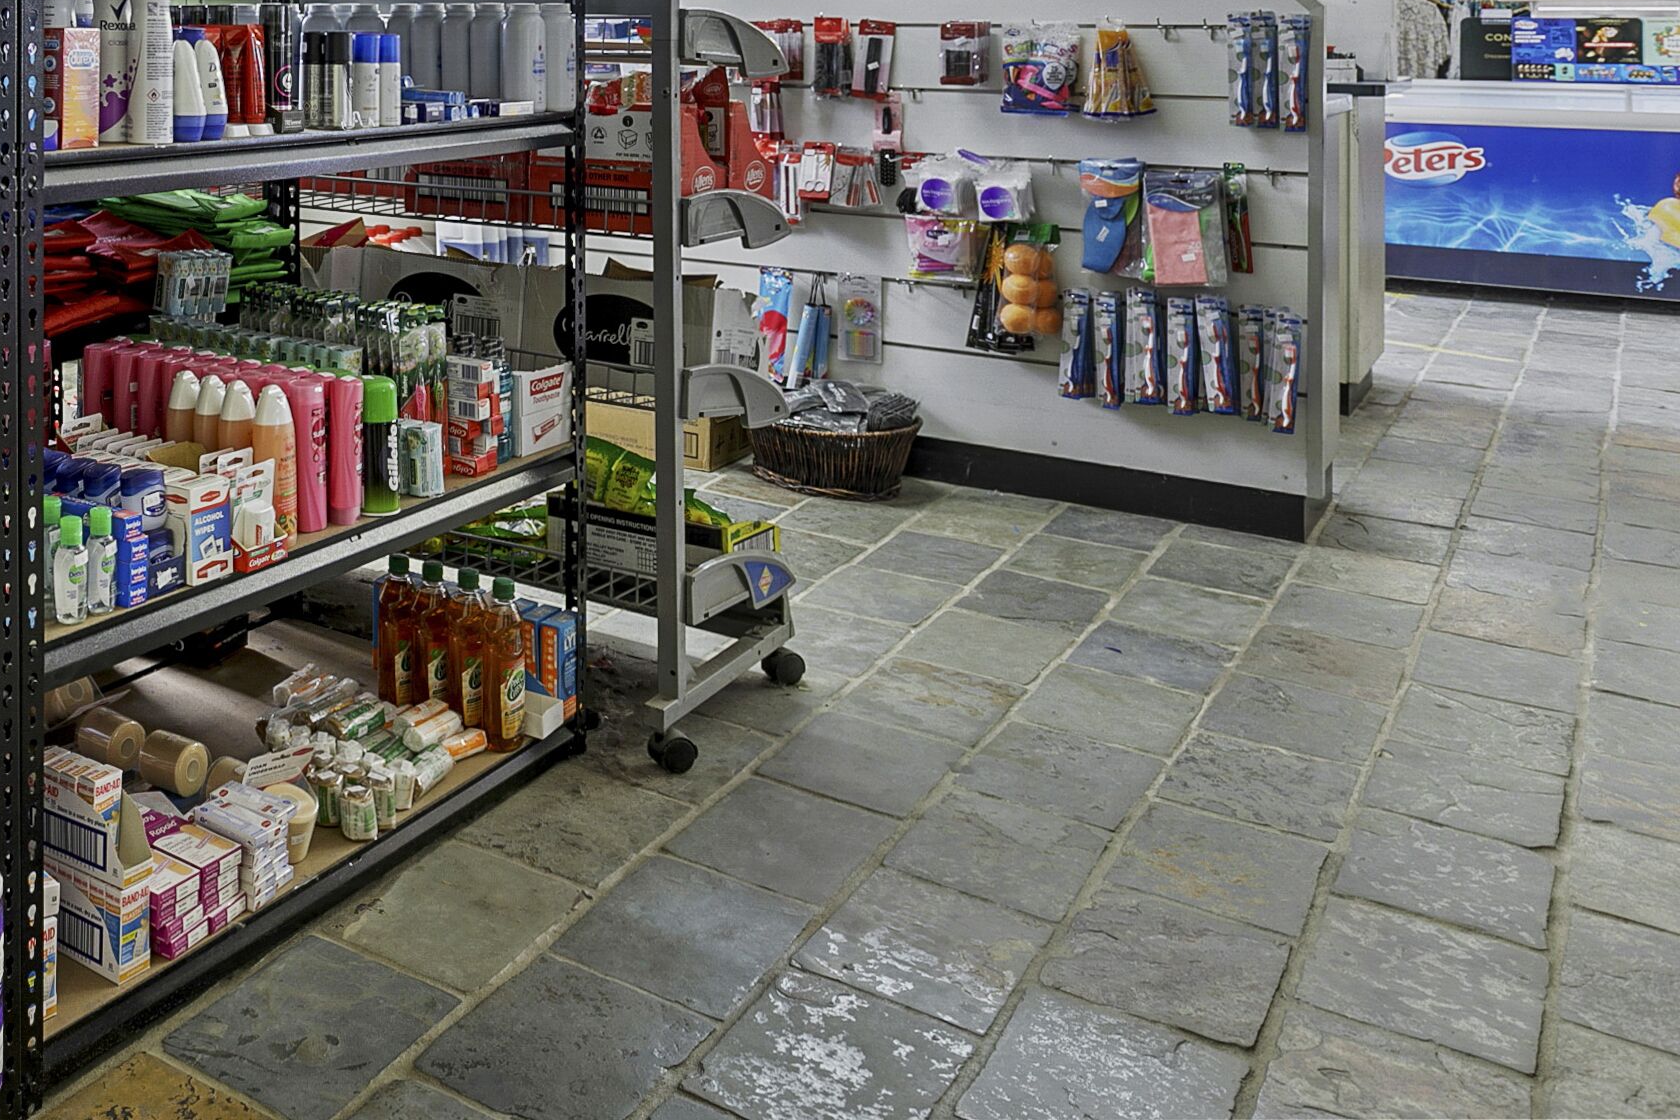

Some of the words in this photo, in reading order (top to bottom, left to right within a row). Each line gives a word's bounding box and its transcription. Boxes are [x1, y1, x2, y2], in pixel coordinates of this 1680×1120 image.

[531, 373, 564, 395] Colgate
[533, 391, 561, 405] Toothpaste
[387, 424, 399, 491] Gillette
[194, 511, 224, 526] ALCOHOL
[194, 523, 215, 536] WIPES
[248, 554, 271, 568] Colgate
[95, 779, 121, 797] BAND-AID
[148, 820, 177, 838] Rapaid
[121, 885, 150, 907] BAND-AID
